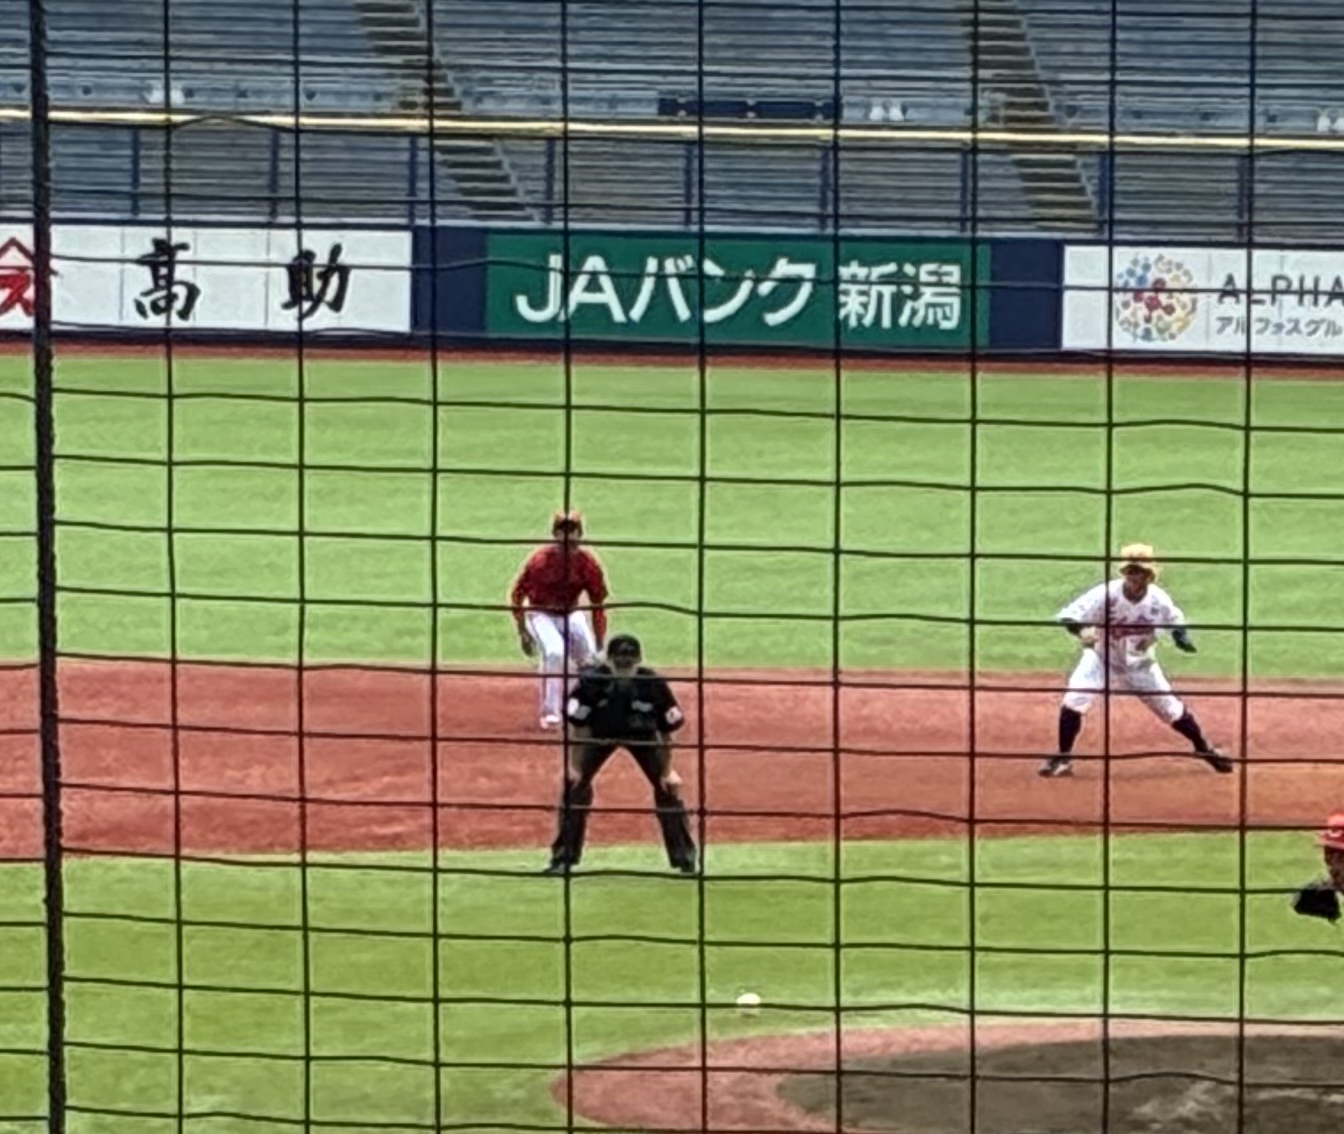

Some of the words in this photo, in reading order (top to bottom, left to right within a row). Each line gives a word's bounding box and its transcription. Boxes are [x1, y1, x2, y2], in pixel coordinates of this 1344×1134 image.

[516, 253, 816, 327] JAバンク
[837, 260, 962, 330] 新潟
